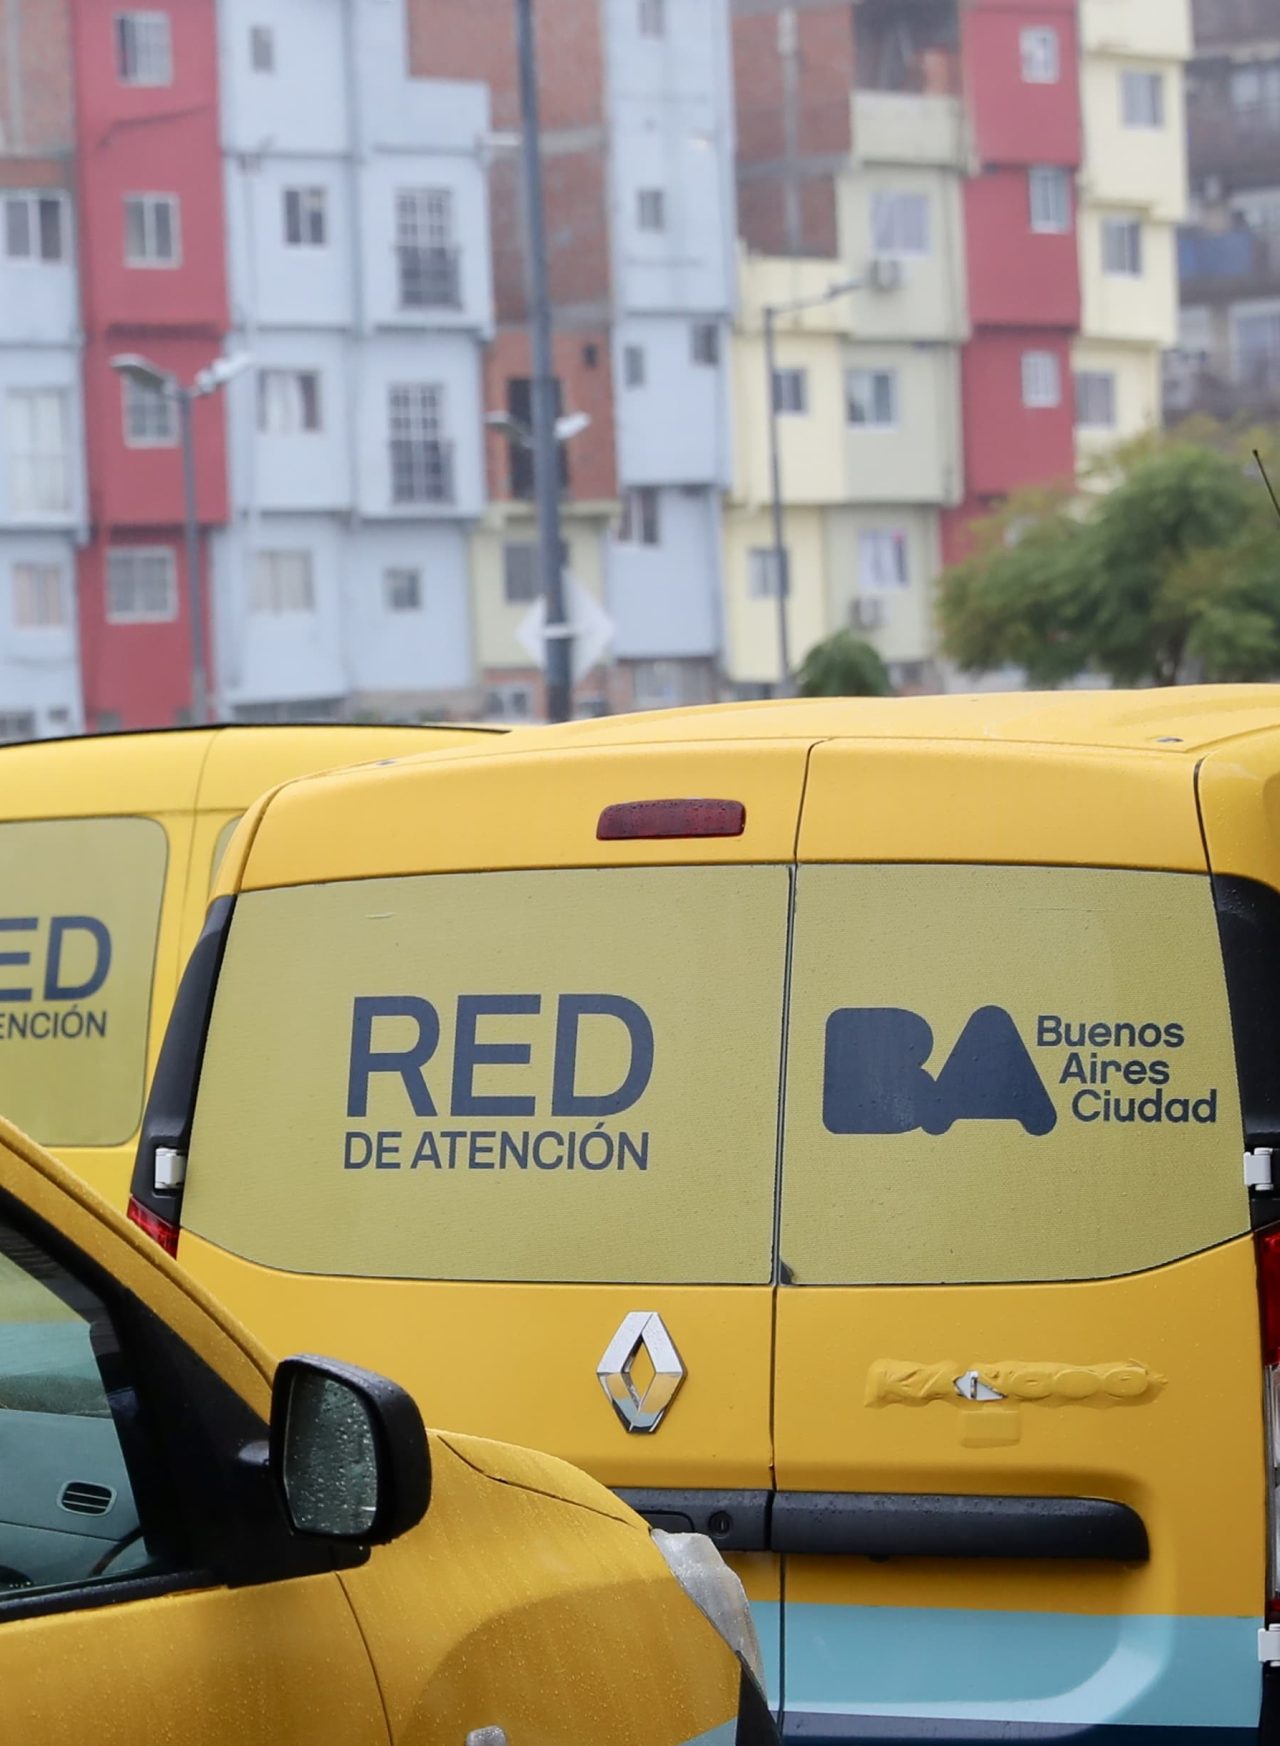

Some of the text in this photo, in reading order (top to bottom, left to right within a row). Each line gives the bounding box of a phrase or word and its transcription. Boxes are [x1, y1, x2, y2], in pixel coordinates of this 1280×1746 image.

[1036, 1015, 1184, 1047] Buenos
[347, 994, 654, 1117] RED
[822, 1005, 1057, 1136] BA
[1058, 1053, 1170, 1084] Aires
[1072, 1089, 1217, 1123] Ciudad
[343, 1122, 649, 1170] DE ATENCIÓN
